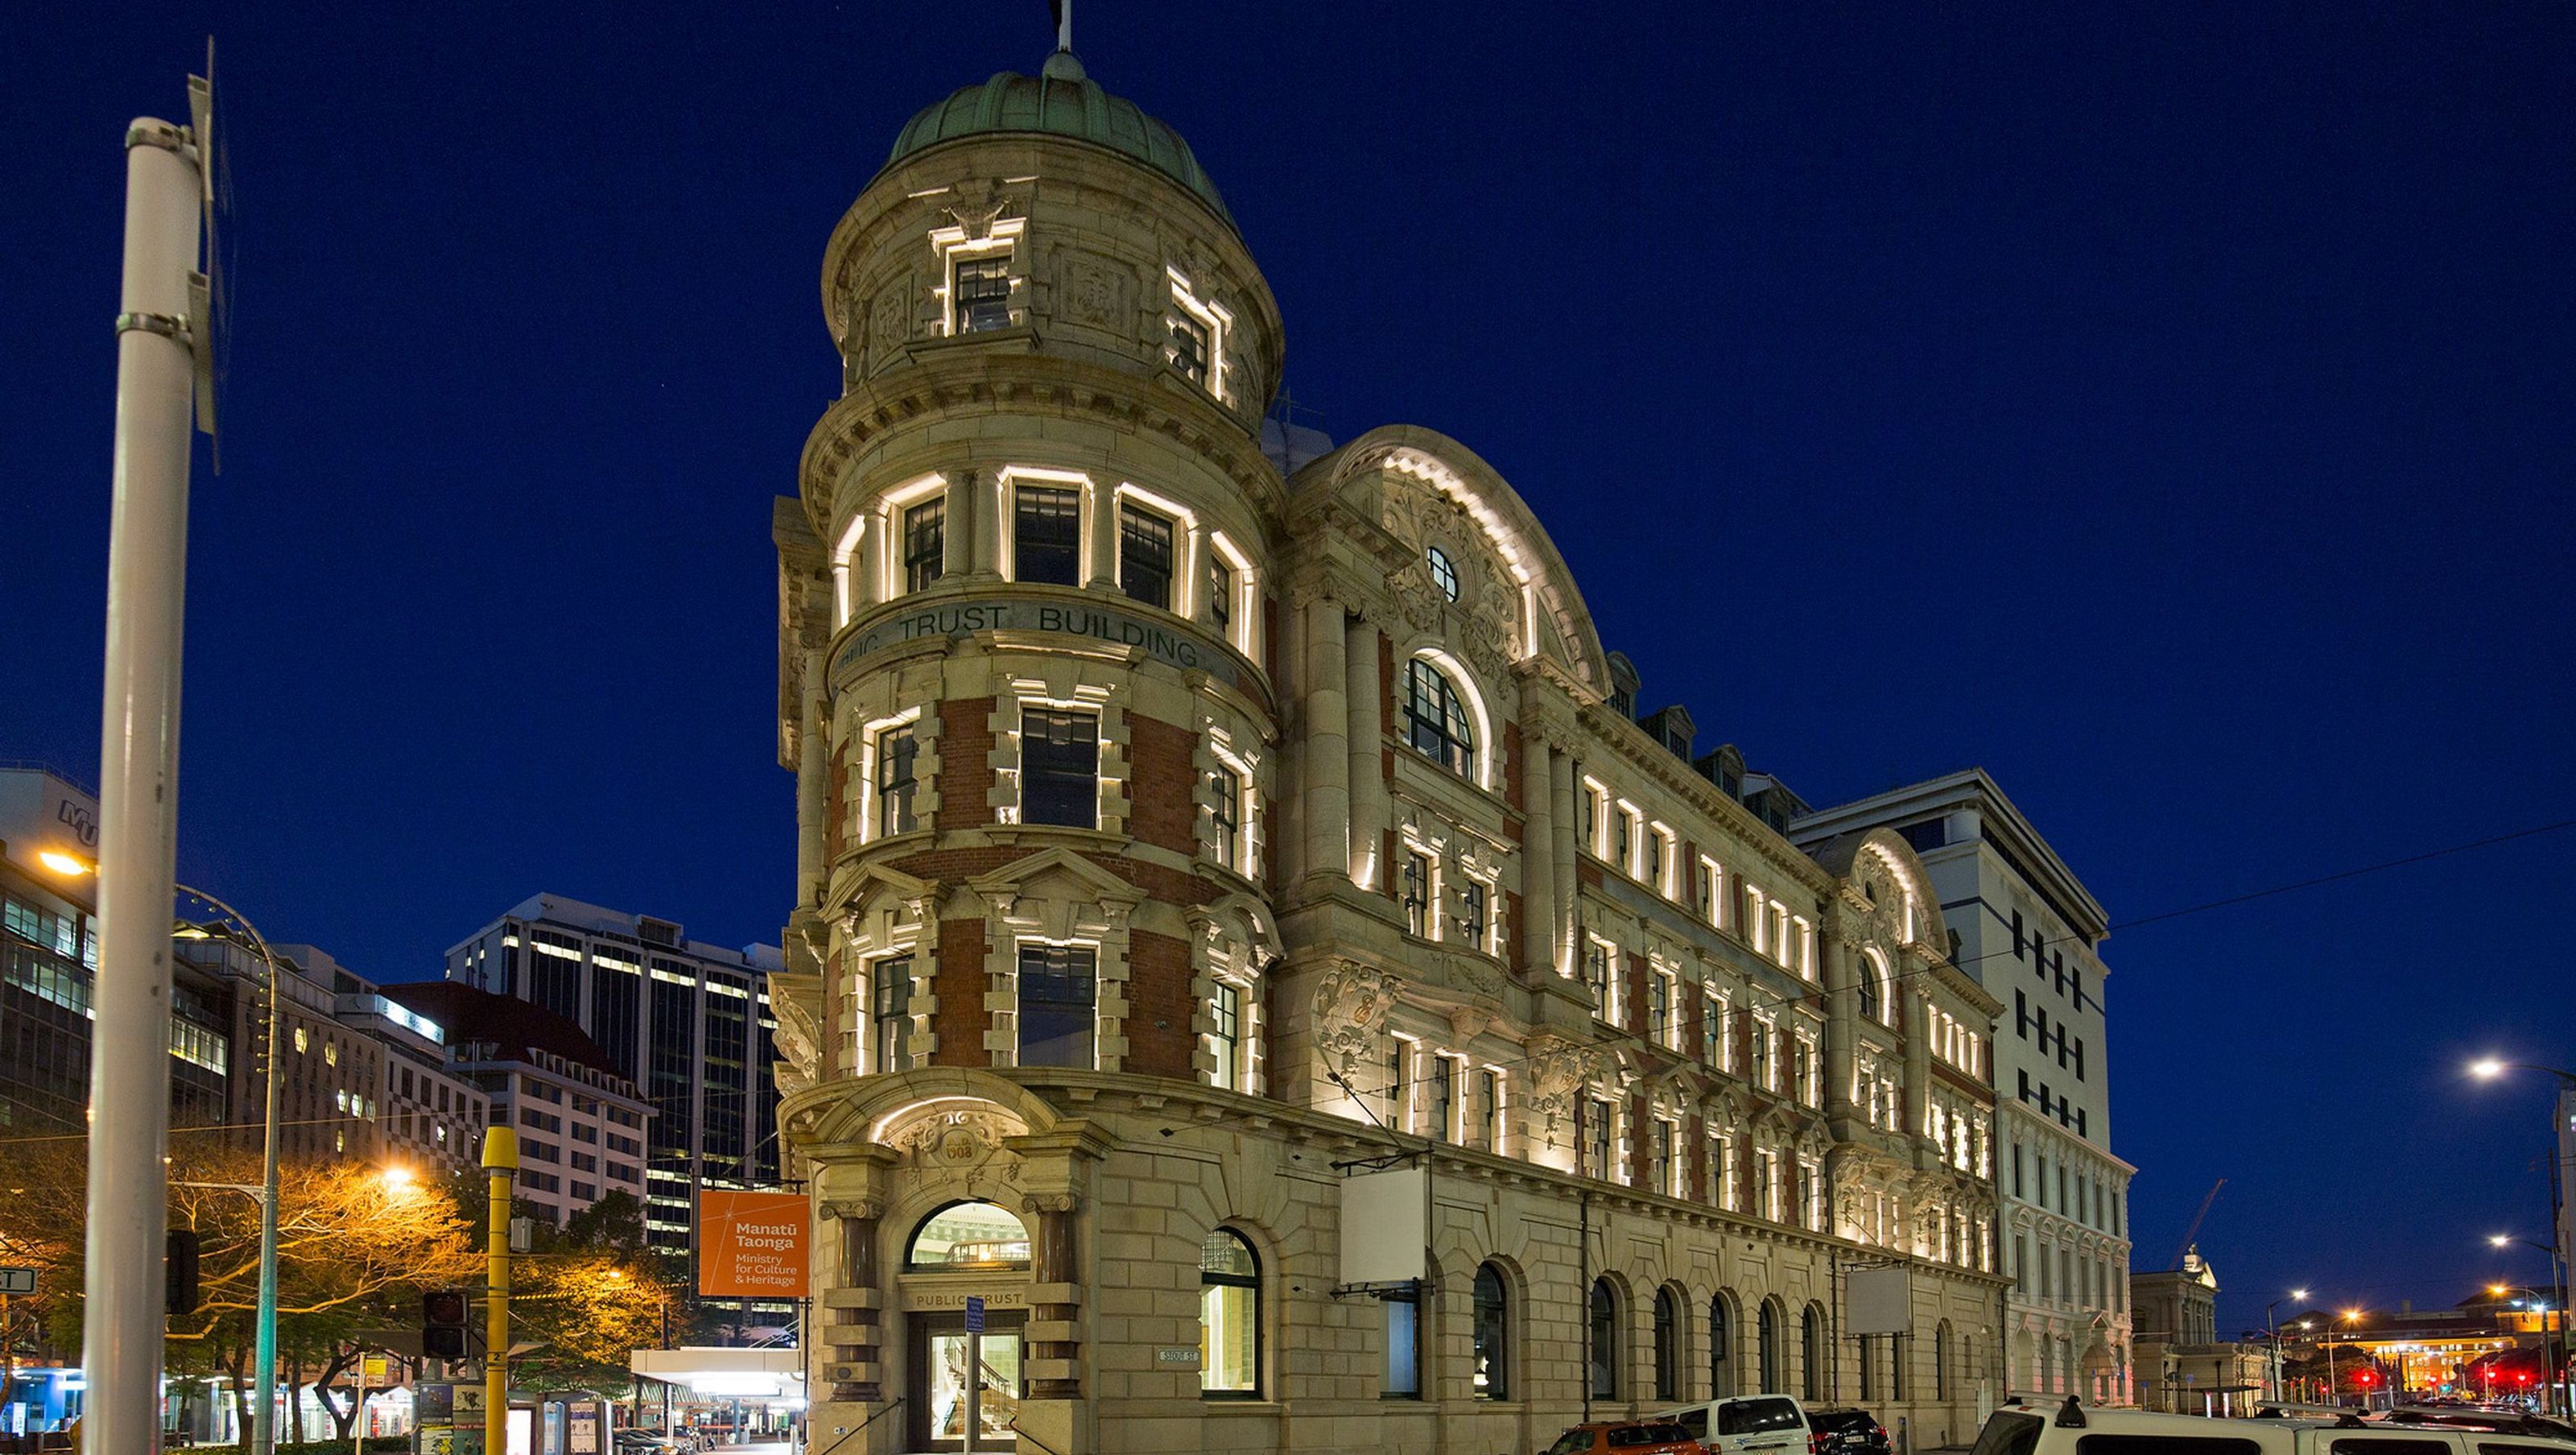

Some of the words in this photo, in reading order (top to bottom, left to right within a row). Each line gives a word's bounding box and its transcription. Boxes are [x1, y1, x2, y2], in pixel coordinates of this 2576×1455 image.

[899, 606, 1008, 640] TRUST
[1039, 607, 1197, 668] BUILDING
[736, 1223, 798, 1236] Manatū
[735, 1235, 795, 1251] Taonga
[736, 1253, 783, 1266] Ministry
[735, 1263, 752, 1274] for
[754, 1264, 798, 1275] Culture
[0, 1271, 16, 1288] T
[735, 1275, 744, 1284] &
[746, 1275, 796, 1288] Heritage
[917, 1296, 965, 1306] PUBLIC
[975, 1293, 1022, 1305] RUST
